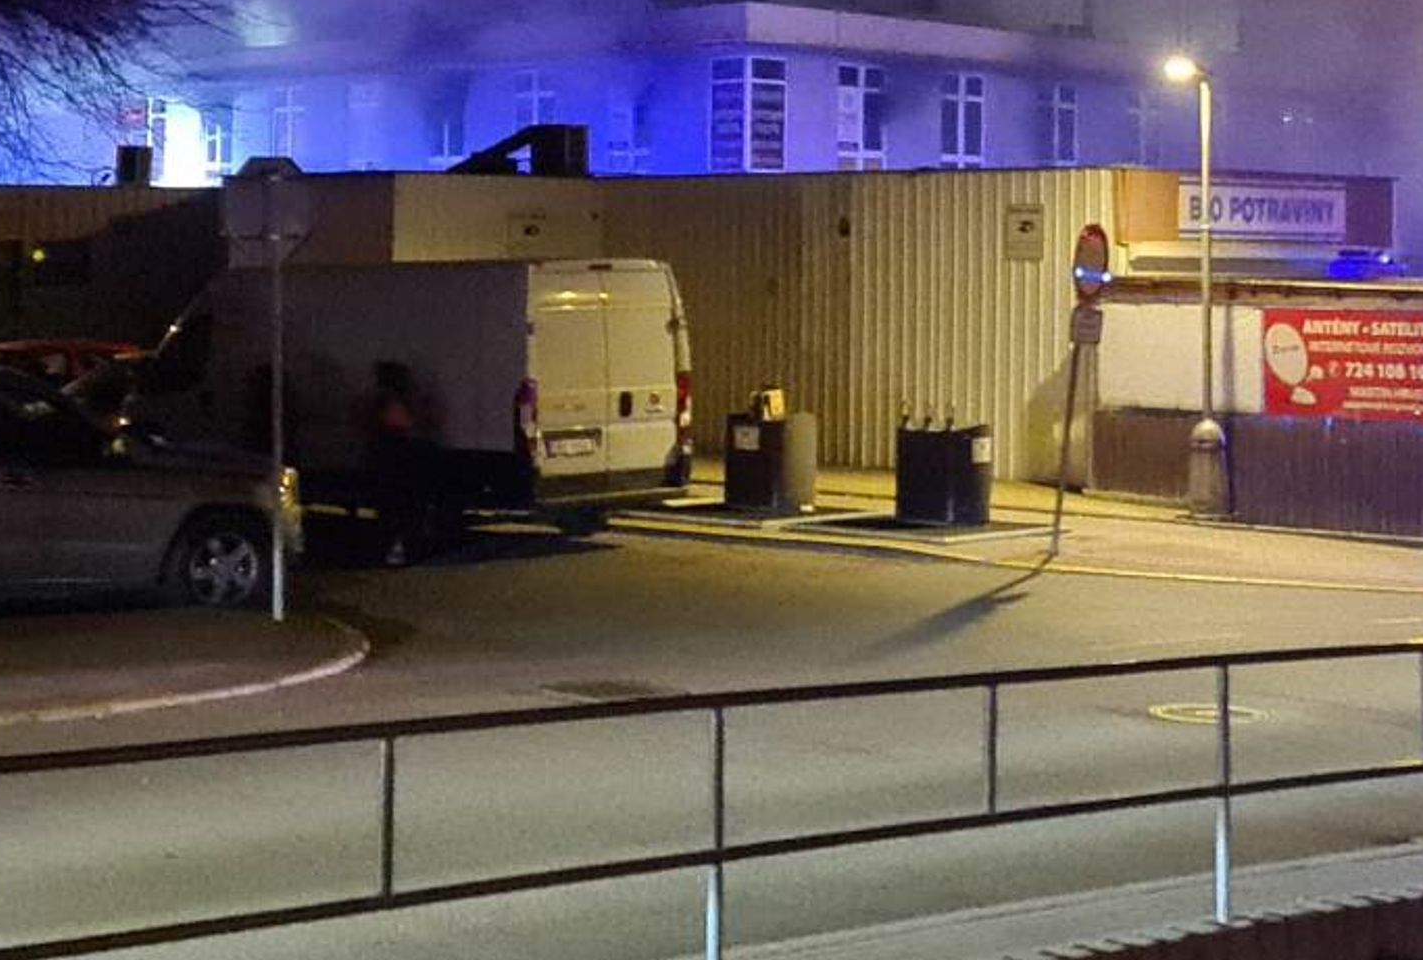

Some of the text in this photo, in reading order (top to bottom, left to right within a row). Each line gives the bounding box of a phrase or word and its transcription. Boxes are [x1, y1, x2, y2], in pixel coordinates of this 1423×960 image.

[1189, 195, 1334, 224] BO POTRAVINY
[1303, 318, 1361, 335] ANTÉNY
[1345, 361, 1375, 378] 724
